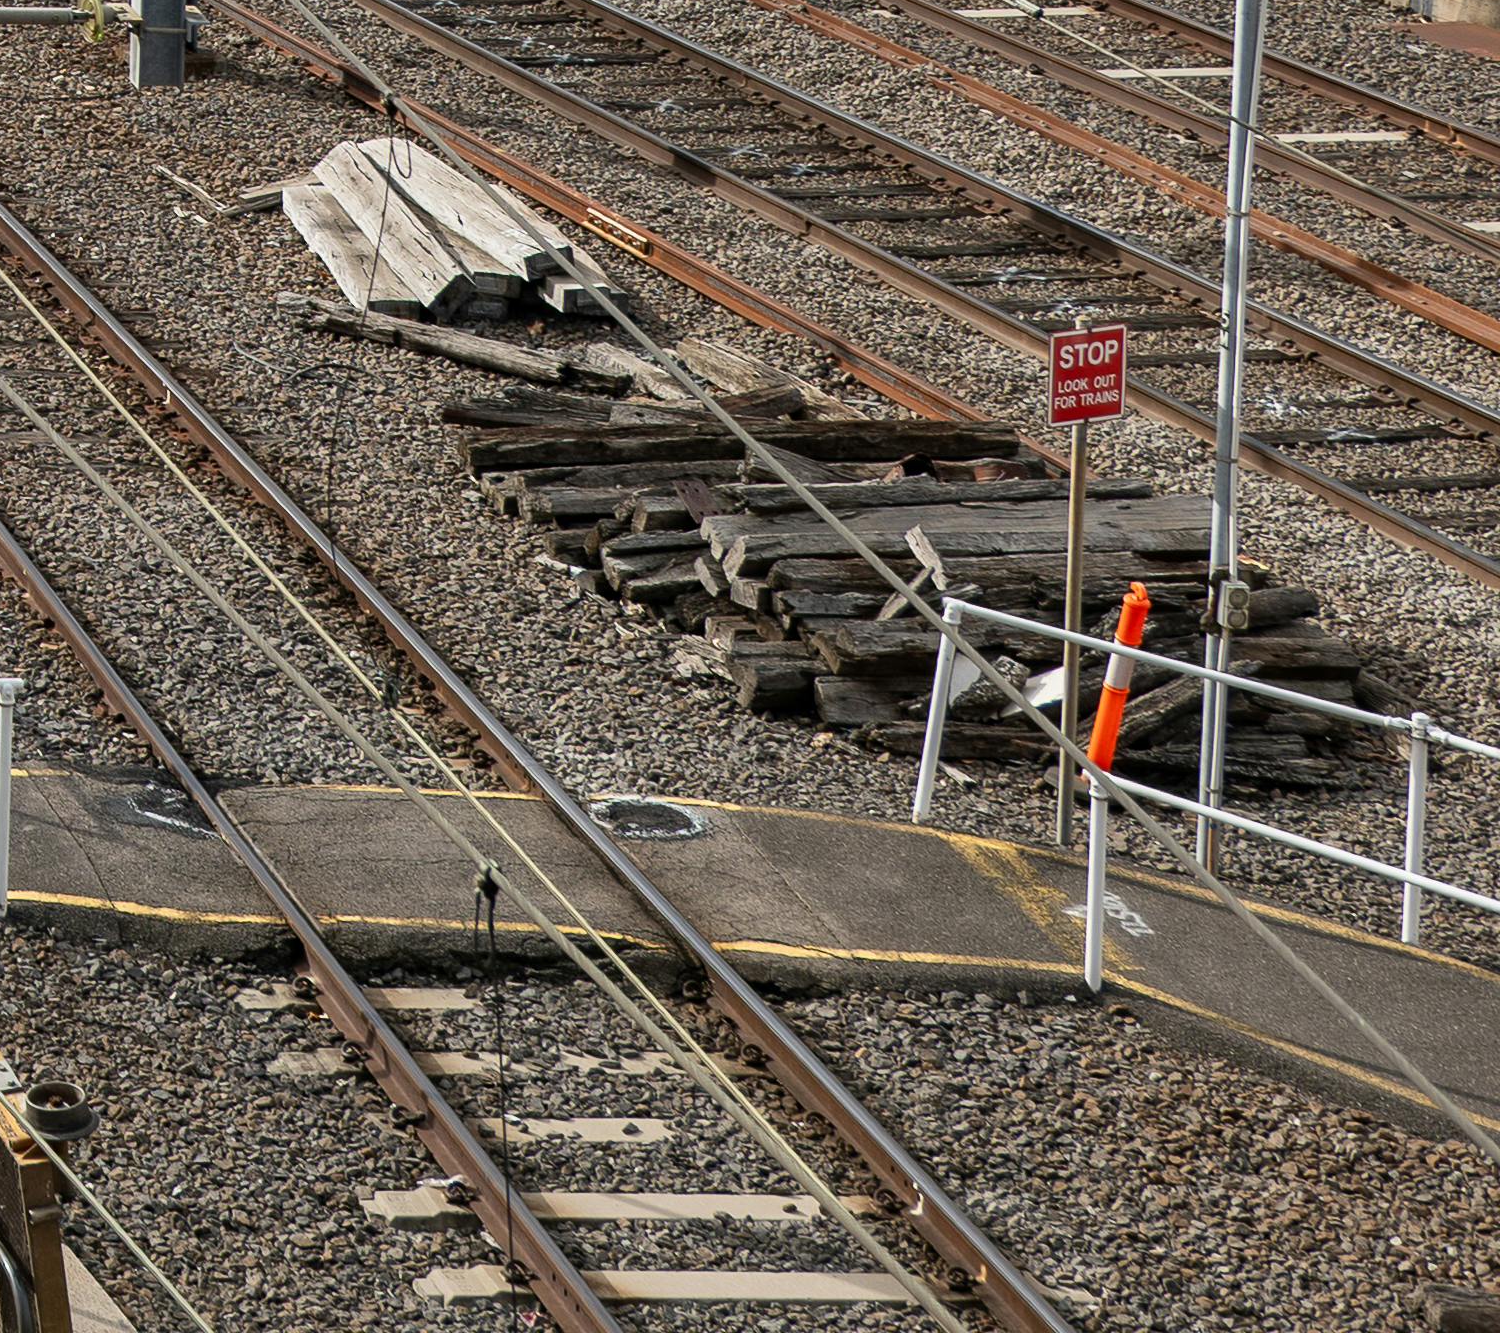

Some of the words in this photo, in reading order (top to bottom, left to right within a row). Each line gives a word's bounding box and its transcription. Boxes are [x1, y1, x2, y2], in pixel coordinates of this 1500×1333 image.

[1059, 339, 1120, 370] STOP
[1057, 377, 1089, 394] LOOK
[1093, 373, 1117, 389] OUT
[1053, 394, 1077, 410] FOR
[1079, 388, 1120, 407] TRAINS
